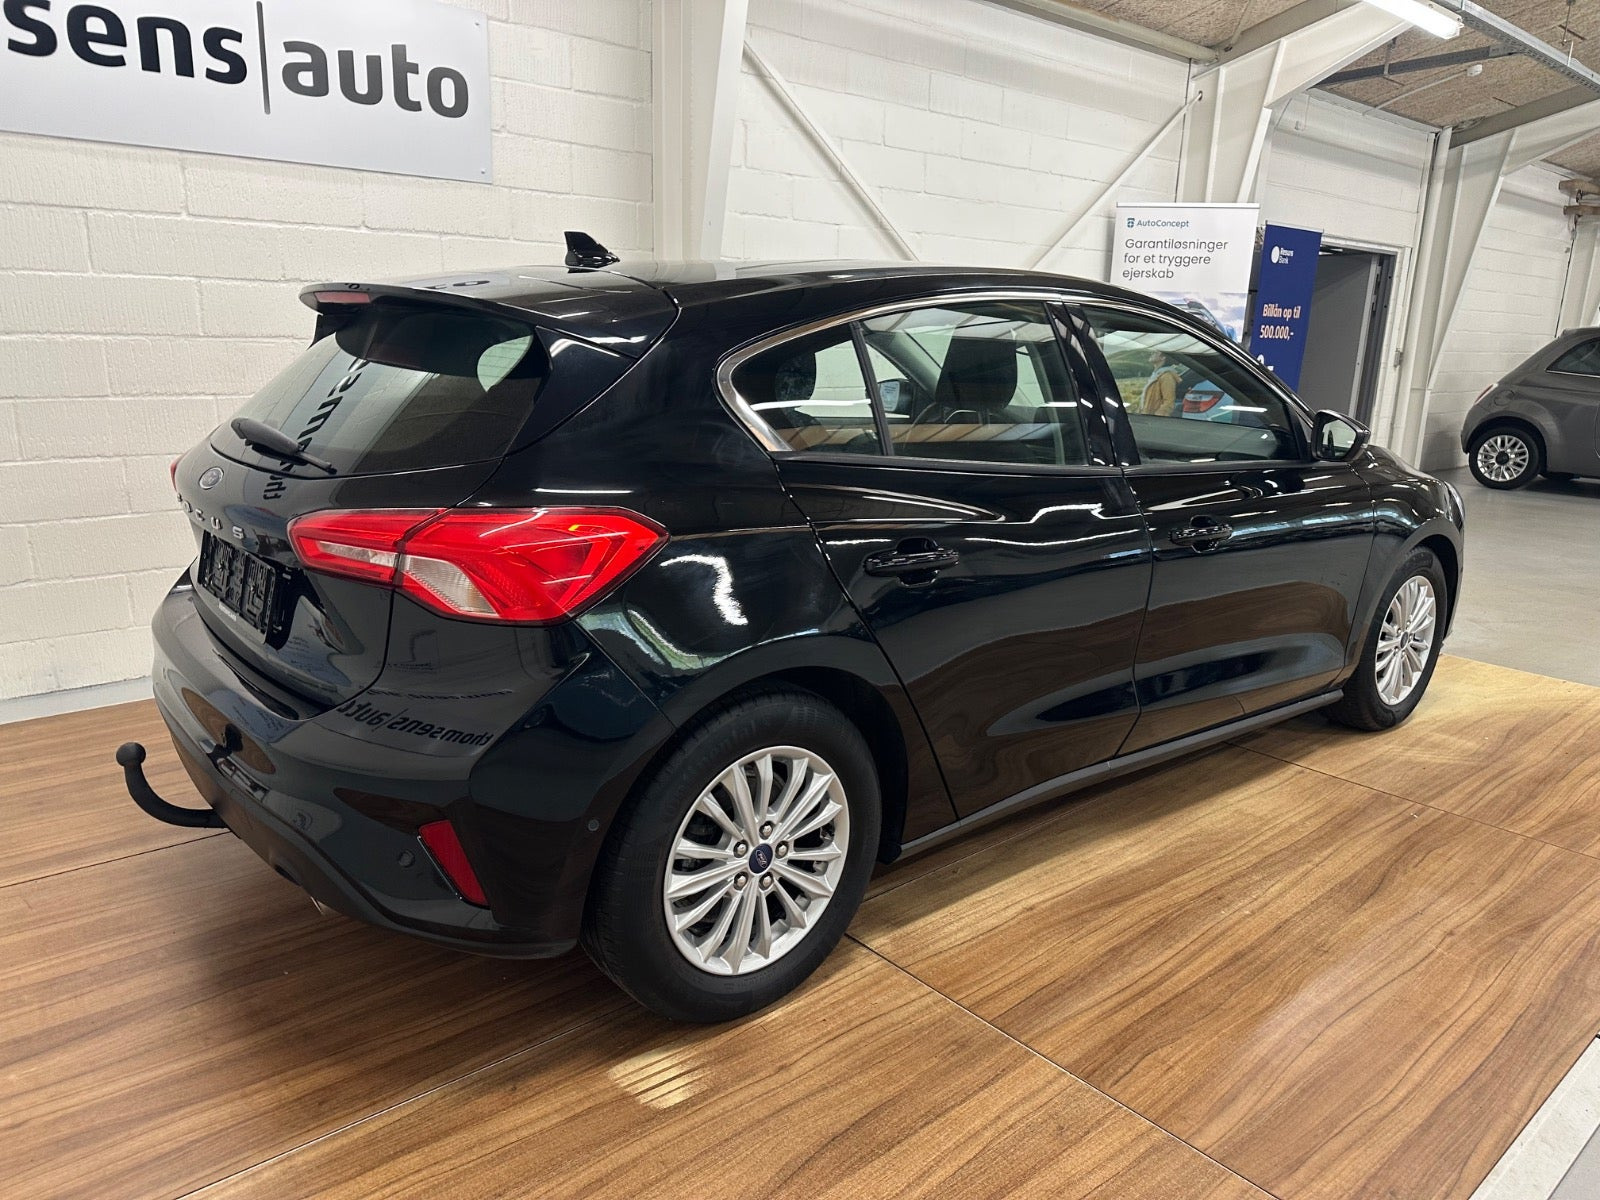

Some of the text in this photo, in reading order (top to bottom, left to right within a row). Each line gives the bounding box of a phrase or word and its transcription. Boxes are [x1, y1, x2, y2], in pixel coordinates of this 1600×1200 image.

[282, 40, 470, 119] auto
[1136, 219, 1190, 229] AutoConcept
[1124, 238, 1229, 253] Garantiløsninger
[1123, 252, 1212, 267] for et tryggere
[1122, 268, 1174, 281] ejerskab
[1283, 308, 1292, 321] op
[1292, 305, 1302, 319] til
